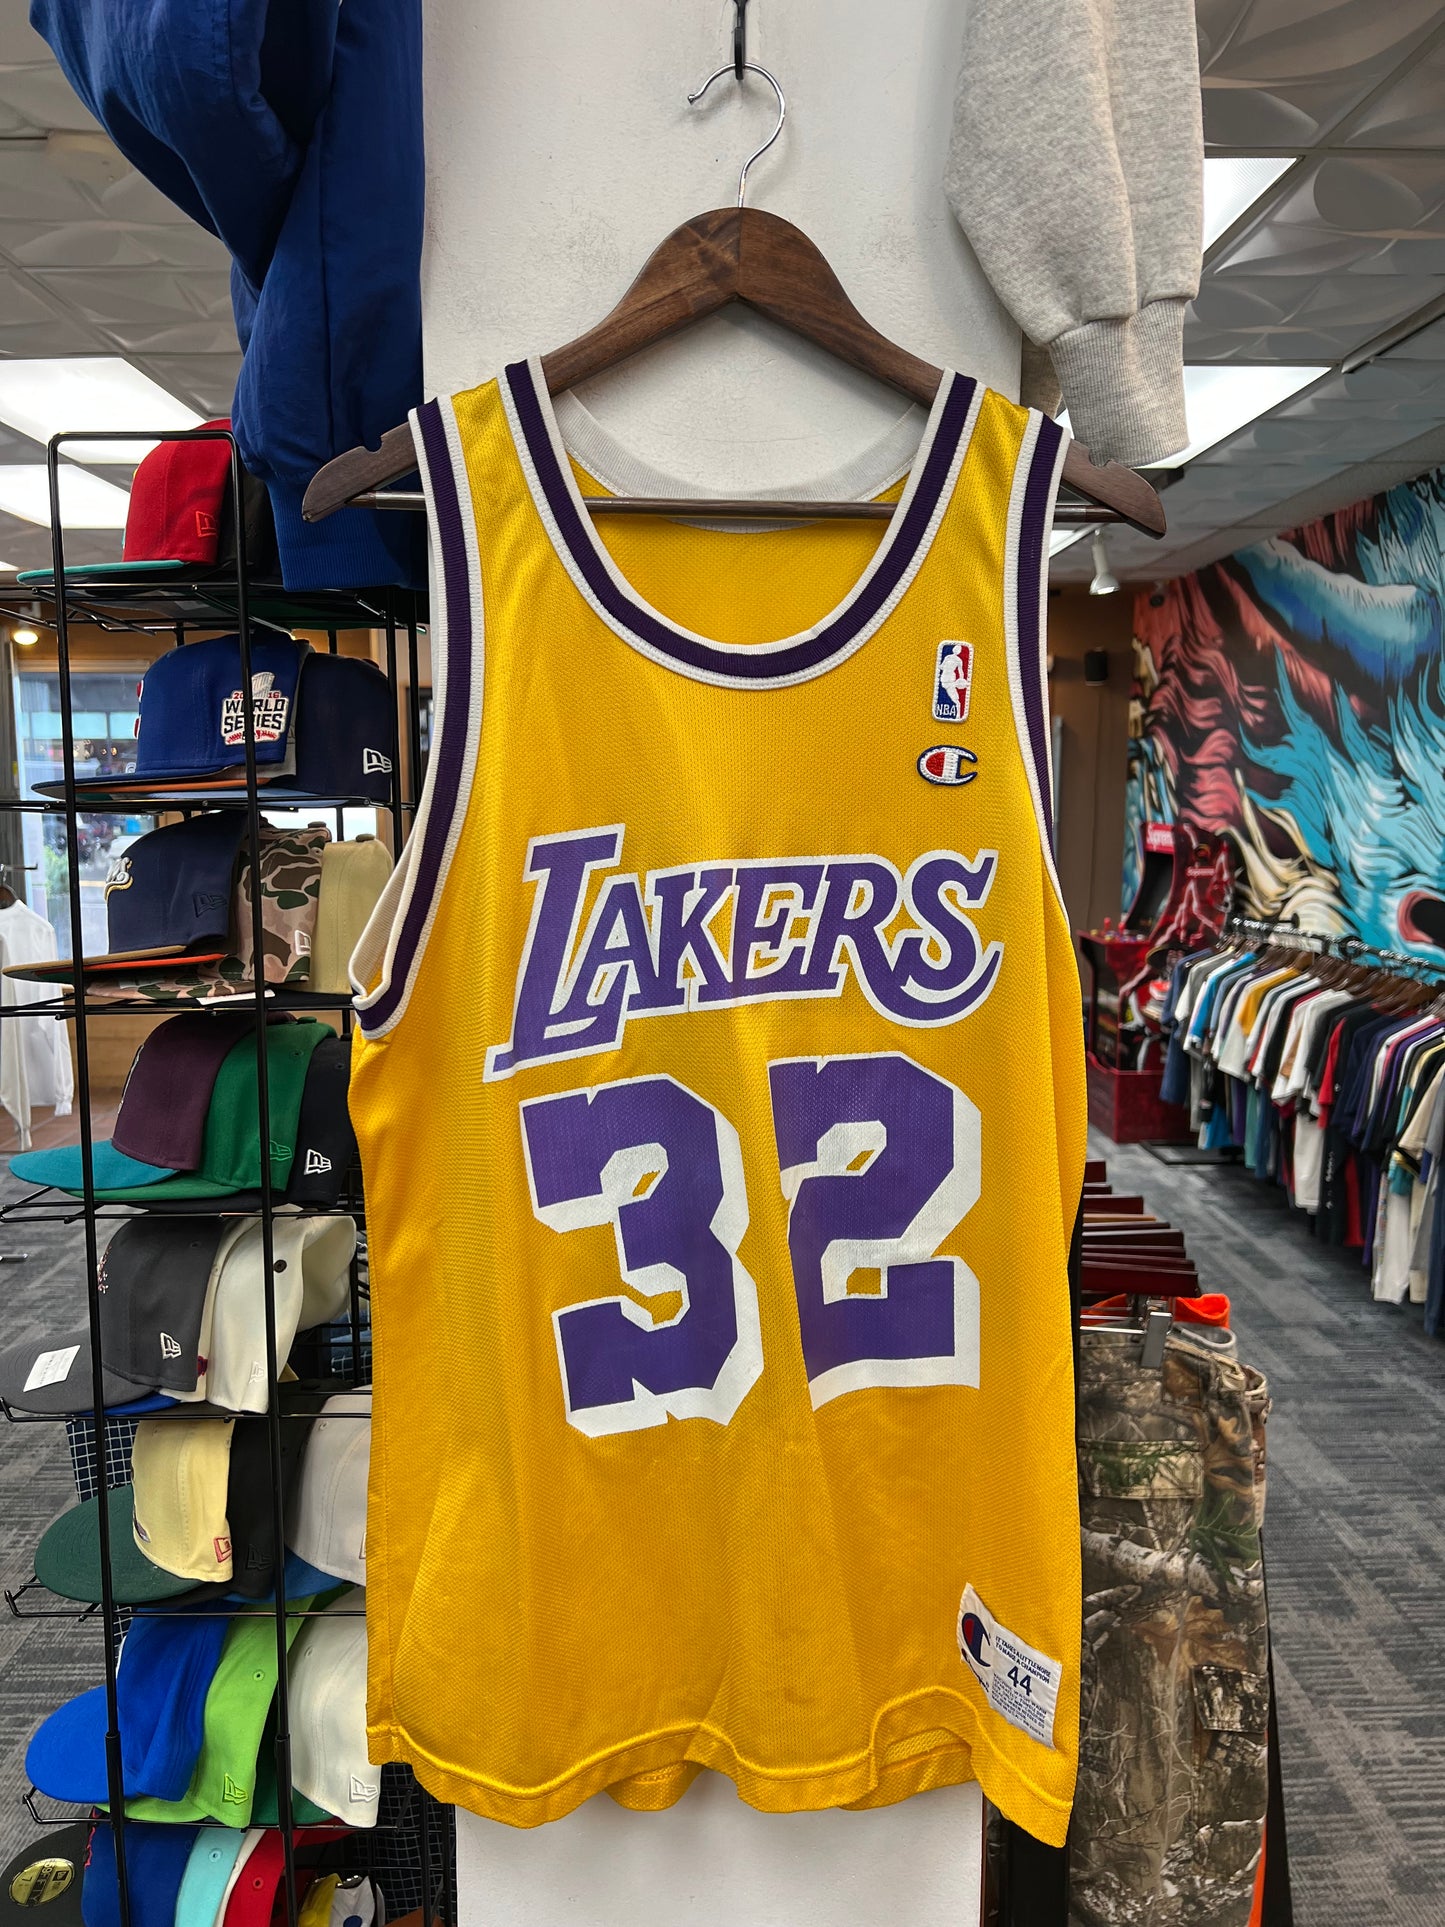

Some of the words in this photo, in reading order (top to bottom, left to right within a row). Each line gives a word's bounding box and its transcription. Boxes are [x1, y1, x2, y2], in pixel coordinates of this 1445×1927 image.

[268, 691, 280, 699] 16
[936, 704, 956, 716] NBA
[224, 713, 283, 734] SEIES
[483, 823, 1005, 1082] LAKERS
[520, 1051, 982, 1438] 32
[1007, 1665, 1032, 1696] 44
[1020, 1661, 1050, 1684] CHAMPION
